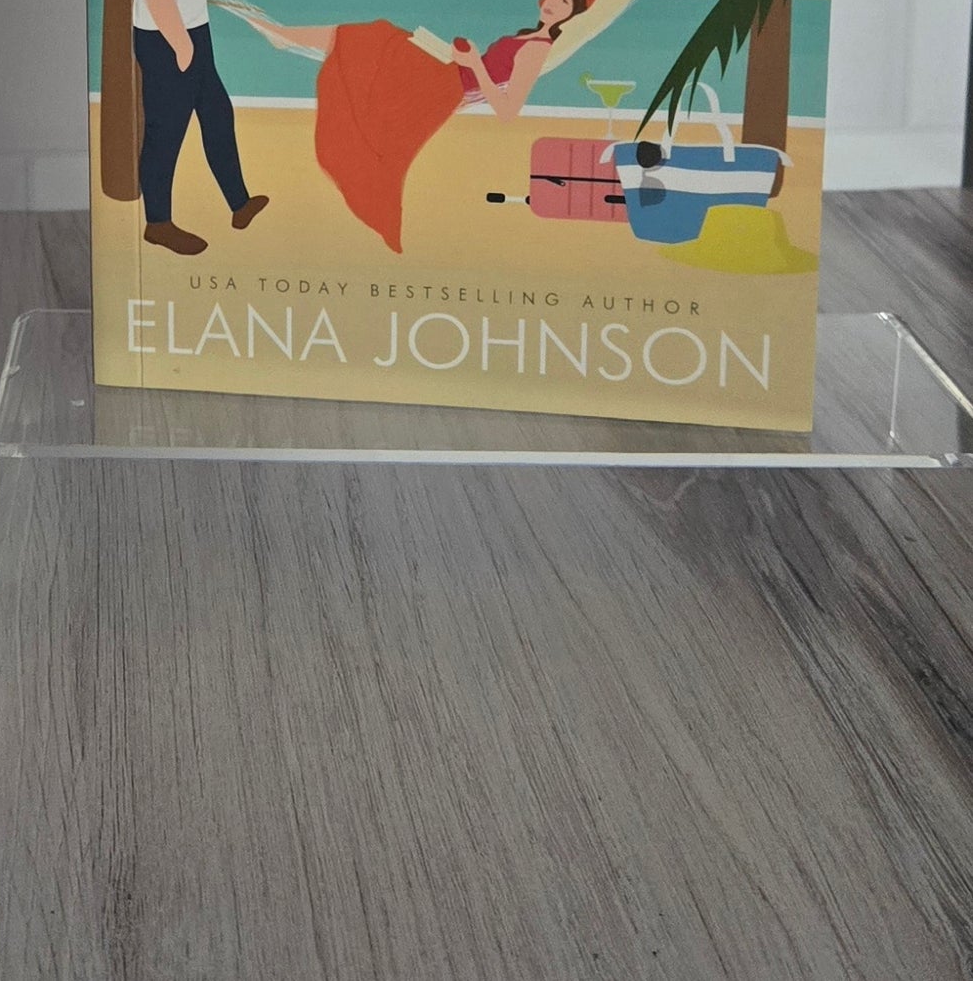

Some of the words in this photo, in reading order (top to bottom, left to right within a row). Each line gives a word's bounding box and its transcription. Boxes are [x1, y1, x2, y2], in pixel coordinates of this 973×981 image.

[188, 276, 239, 292] USA
[258, 278, 350, 297] TODAY
[370, 284, 561, 307] BESTSELLING
[582, 295, 703, 317] AUTHOR
[126, 298, 348, 363] ELANA
[373, 311, 772, 391] JOHNSON
